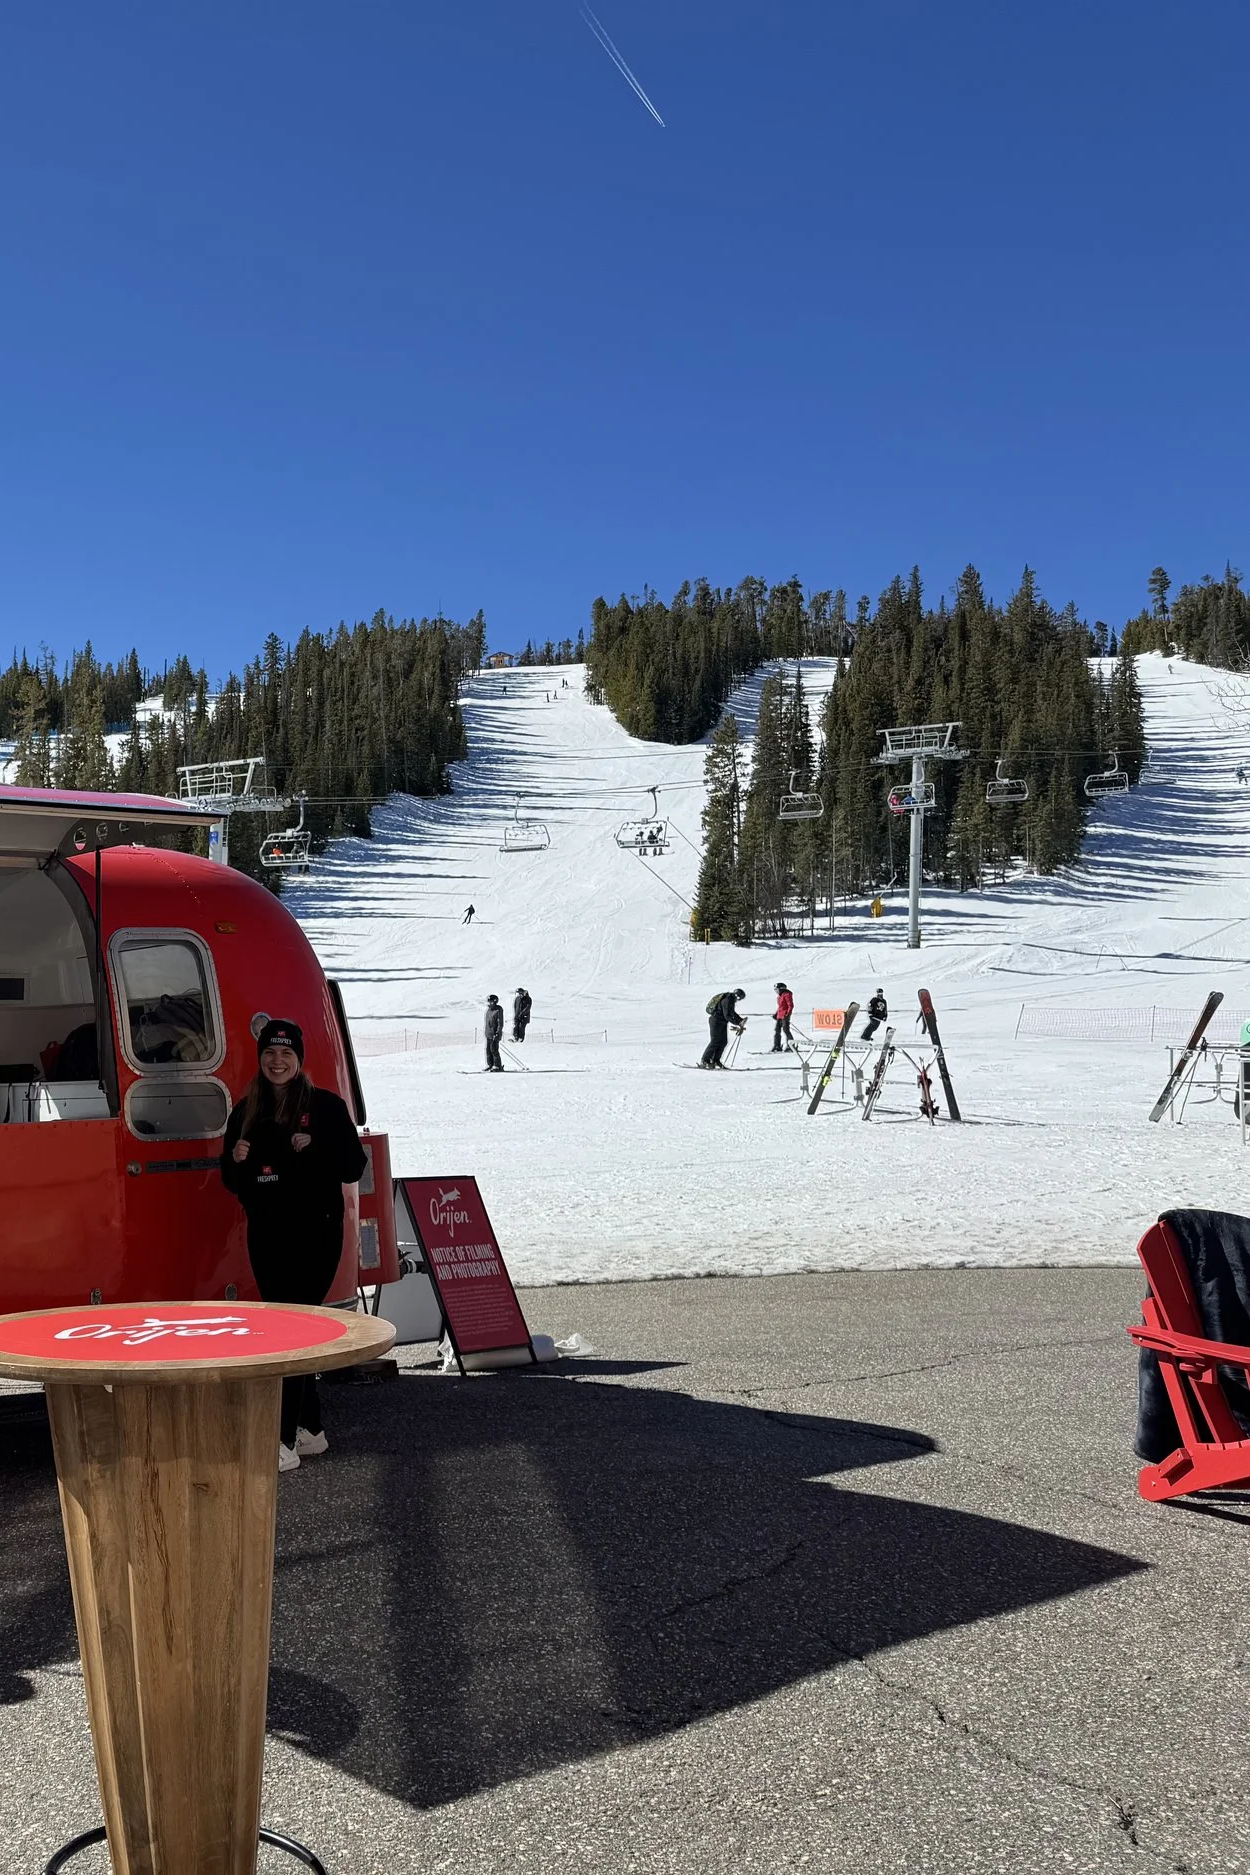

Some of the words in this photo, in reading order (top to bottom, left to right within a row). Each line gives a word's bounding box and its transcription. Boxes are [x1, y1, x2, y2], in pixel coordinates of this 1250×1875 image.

[430, 1198, 470, 1238] Orijen
[430, 1246, 457, 1263] NOTICE
[455, 1246, 467, 1262] OF
[465, 1244, 495, 1261] FILMING
[436, 1264, 453, 1281] AND
[451, 1260, 501, 1279] PHOTOGRAPHY
[54, 1324, 251, 1345] Orijen
